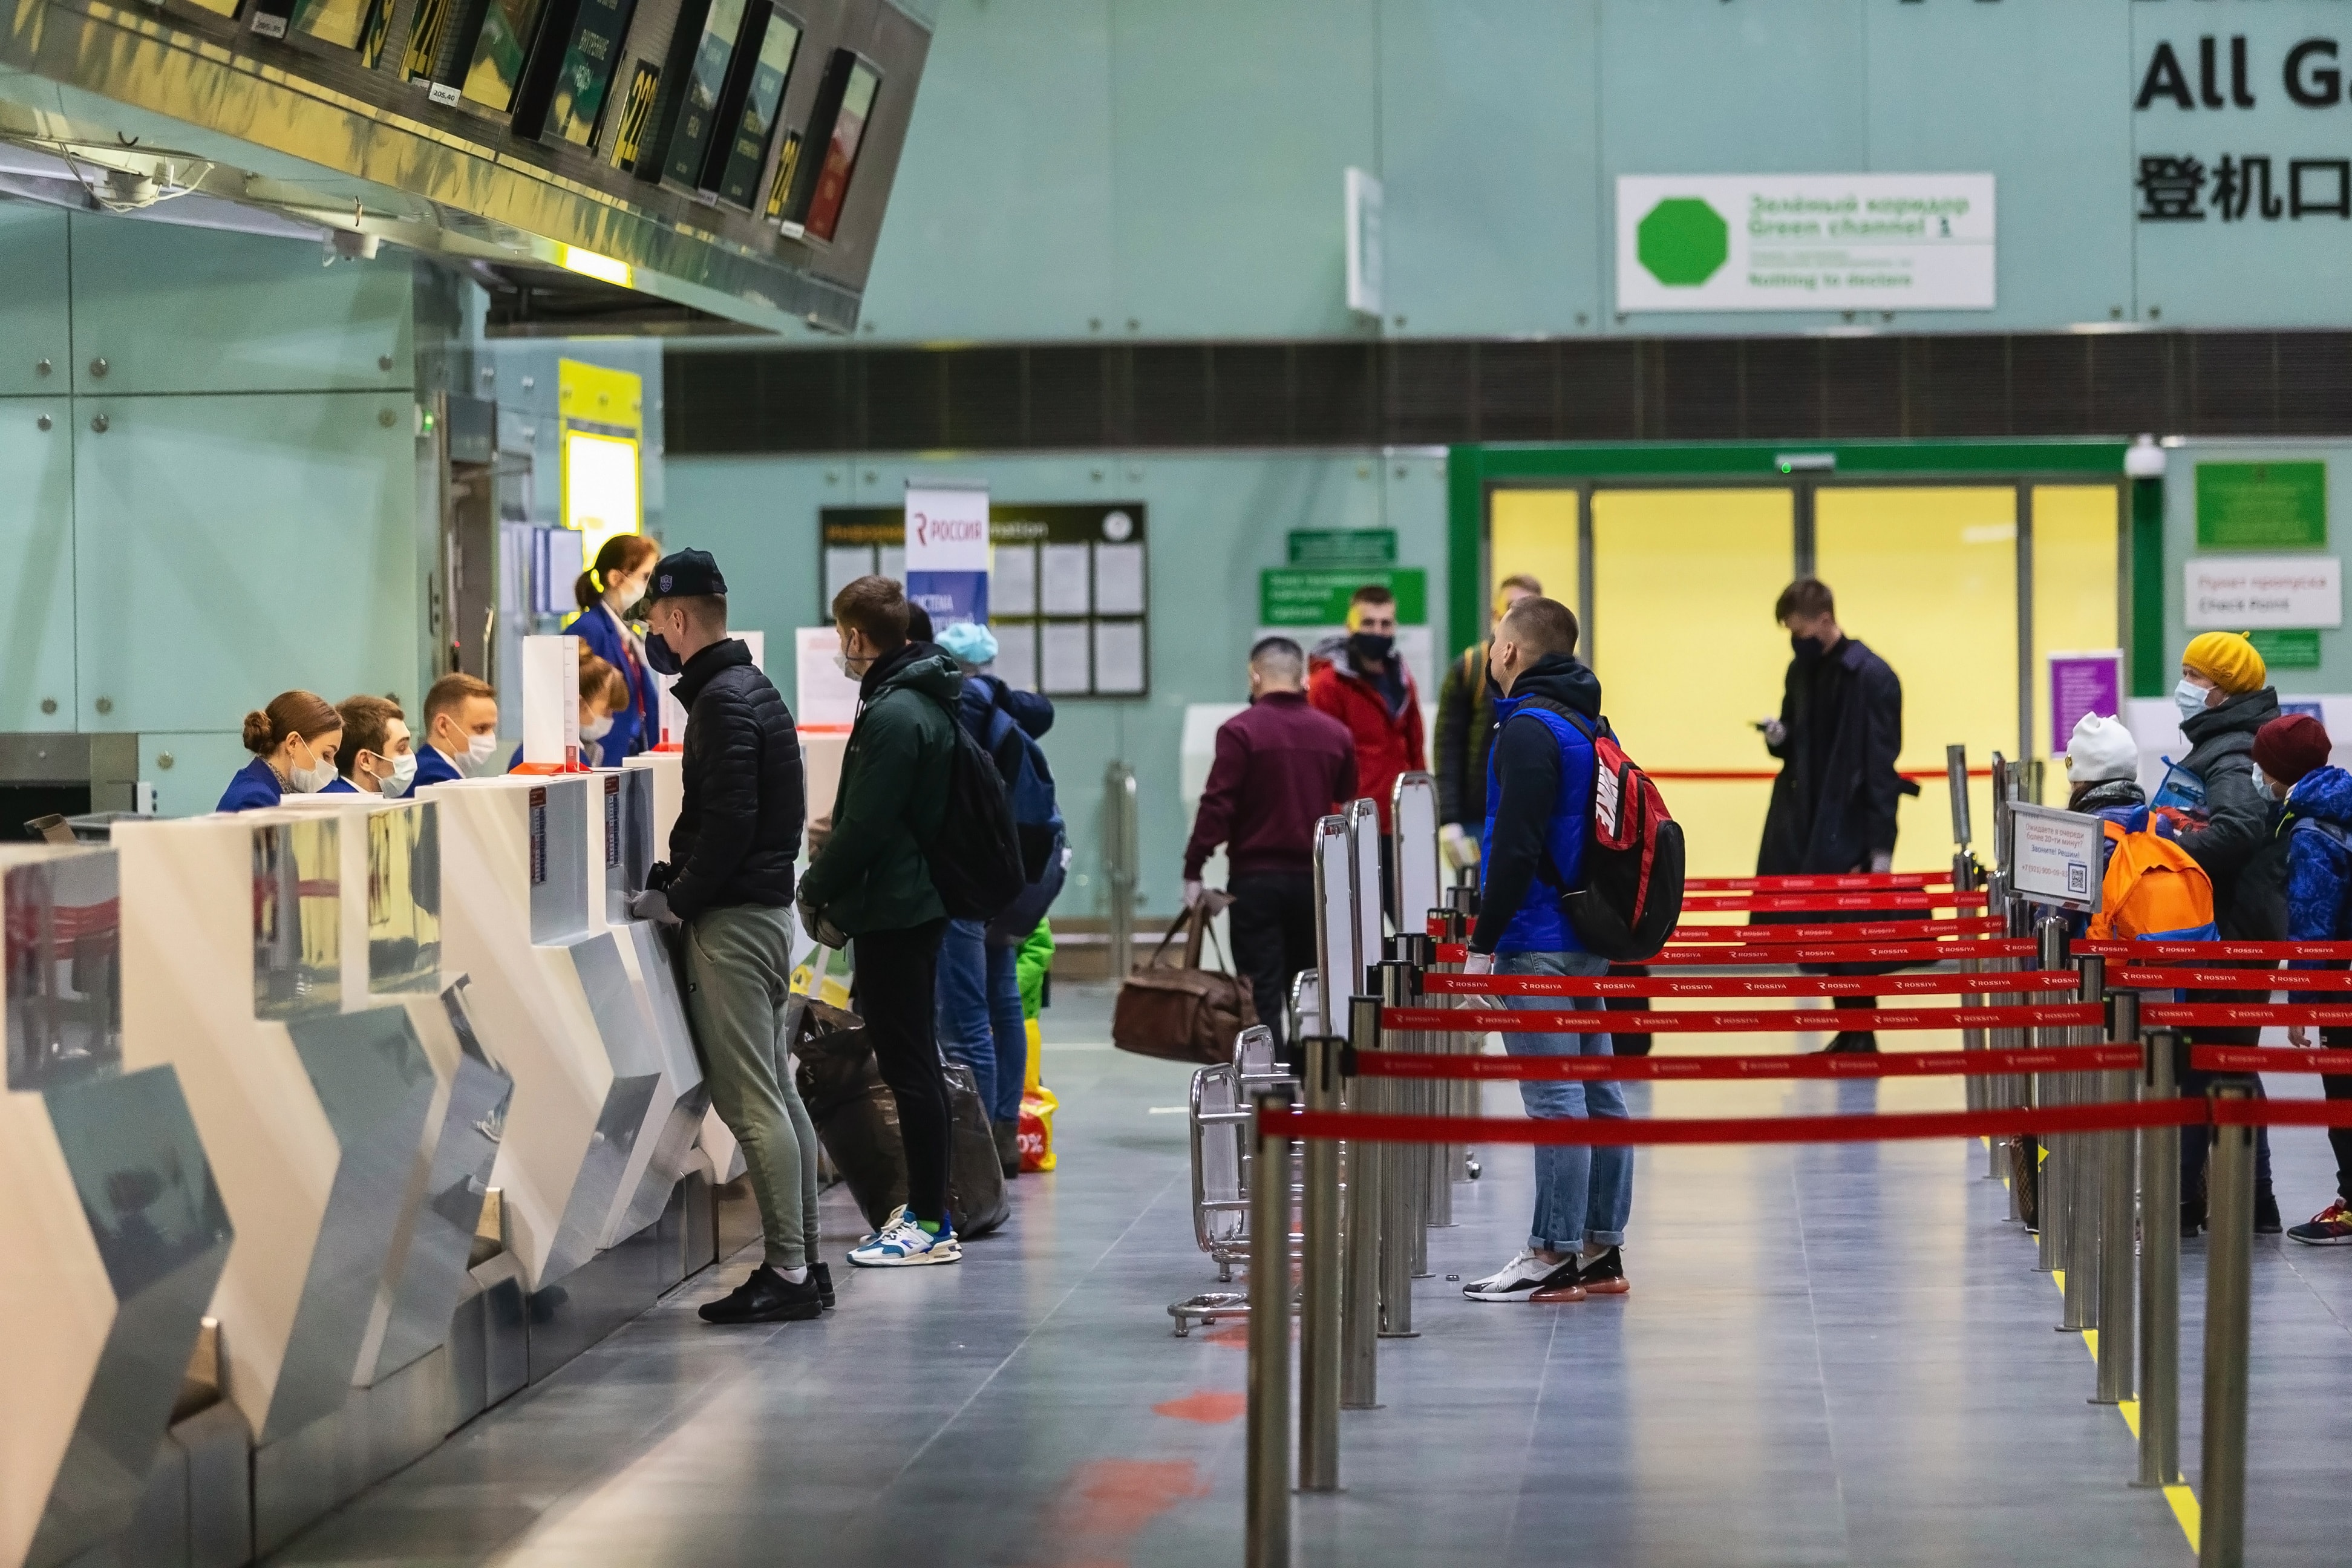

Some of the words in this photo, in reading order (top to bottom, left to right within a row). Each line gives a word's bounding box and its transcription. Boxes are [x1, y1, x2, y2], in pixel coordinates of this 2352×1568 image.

[2133, 34, 2256, 111] All
[2282, 36, 2352, 109] G
[433, 90, 456, 102] 205.40
[2134, 152, 2351, 223] 登机口
[1747, 217, 1820, 237] Green
[929, 520, 982, 541] РОССИЯ
[2025, 823, 2054, 834] Ожидаете
[2059, 830, 2084, 839] очереди
[2027, 832, 2044, 842] более
[1017, 1133, 1044, 1153] 0%
